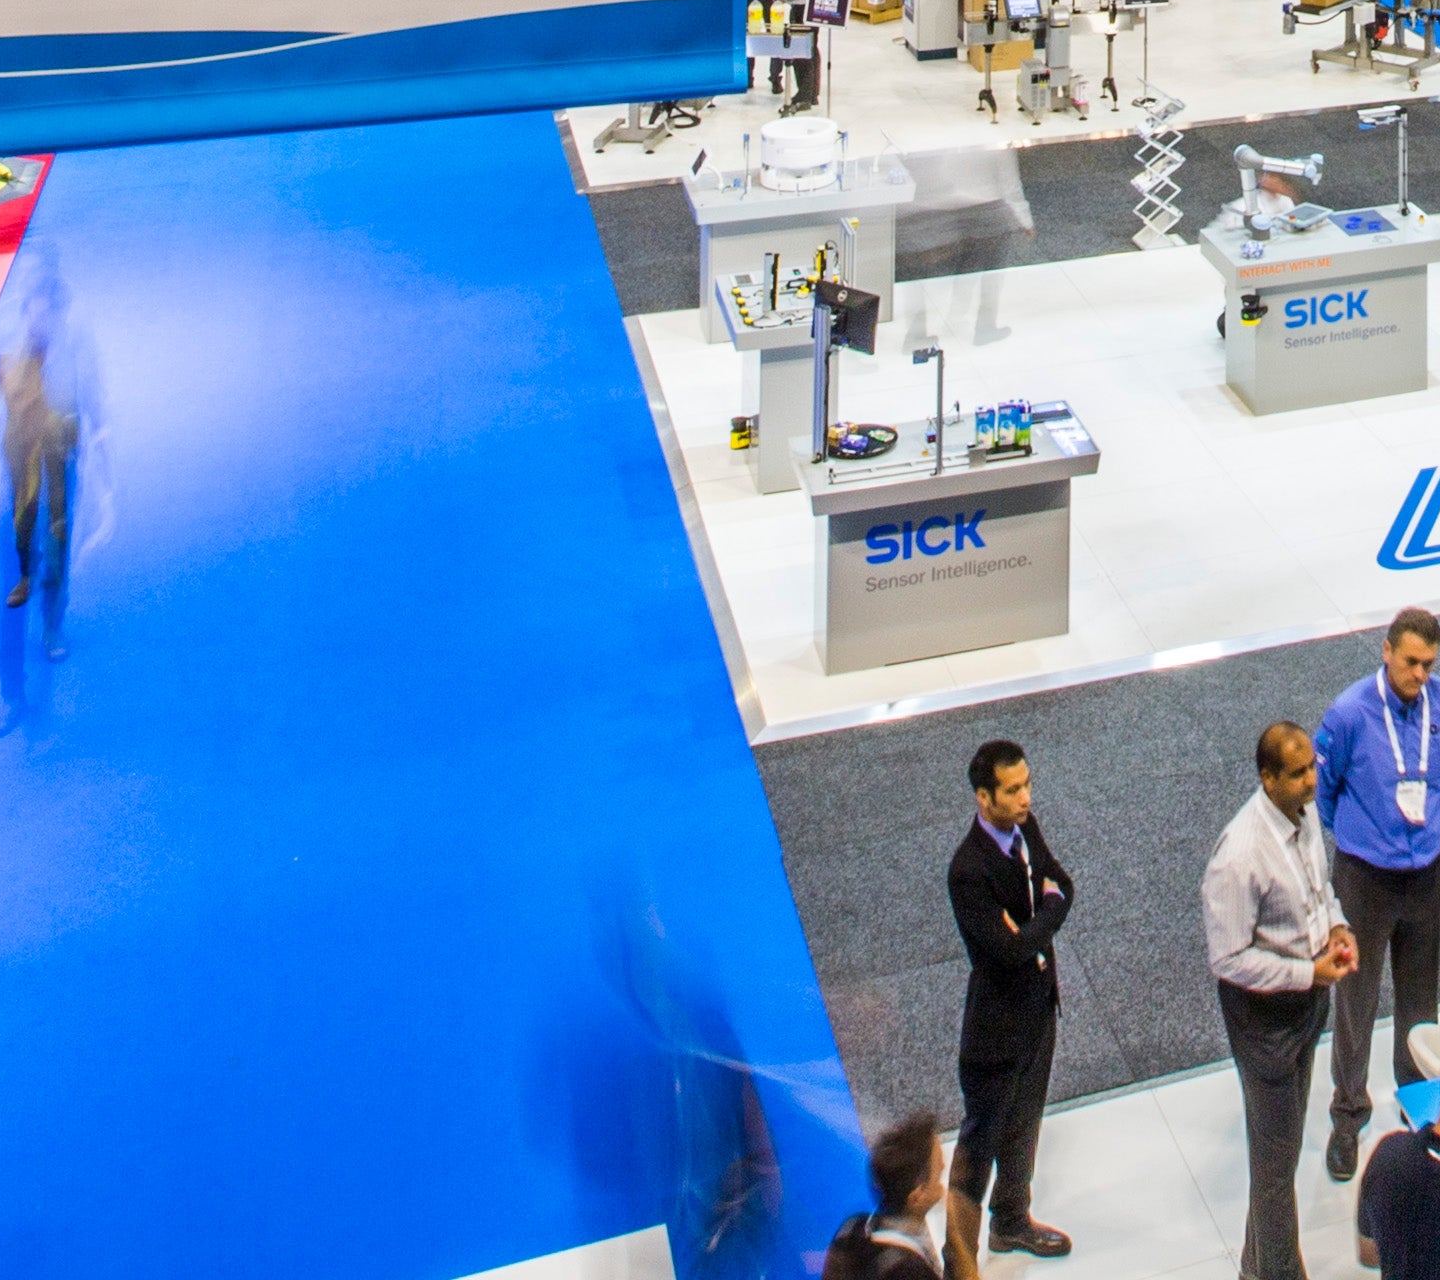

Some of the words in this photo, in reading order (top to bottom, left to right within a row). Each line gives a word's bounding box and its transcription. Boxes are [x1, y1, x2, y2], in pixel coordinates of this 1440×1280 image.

[1239, 262, 1287, 279] INTERACT
[1290, 259, 1315, 272] WITH
[1317, 256, 1333, 269] ME
[1284, 289, 1369, 329] SICK
[1284, 335, 1325, 349] Sensor
[1330, 323, 1401, 343] Intelligence.
[865, 510, 987, 565] SICK
[865, 569, 926, 592] Sensor
[931, 555, 1033, 582] Intelligence.
